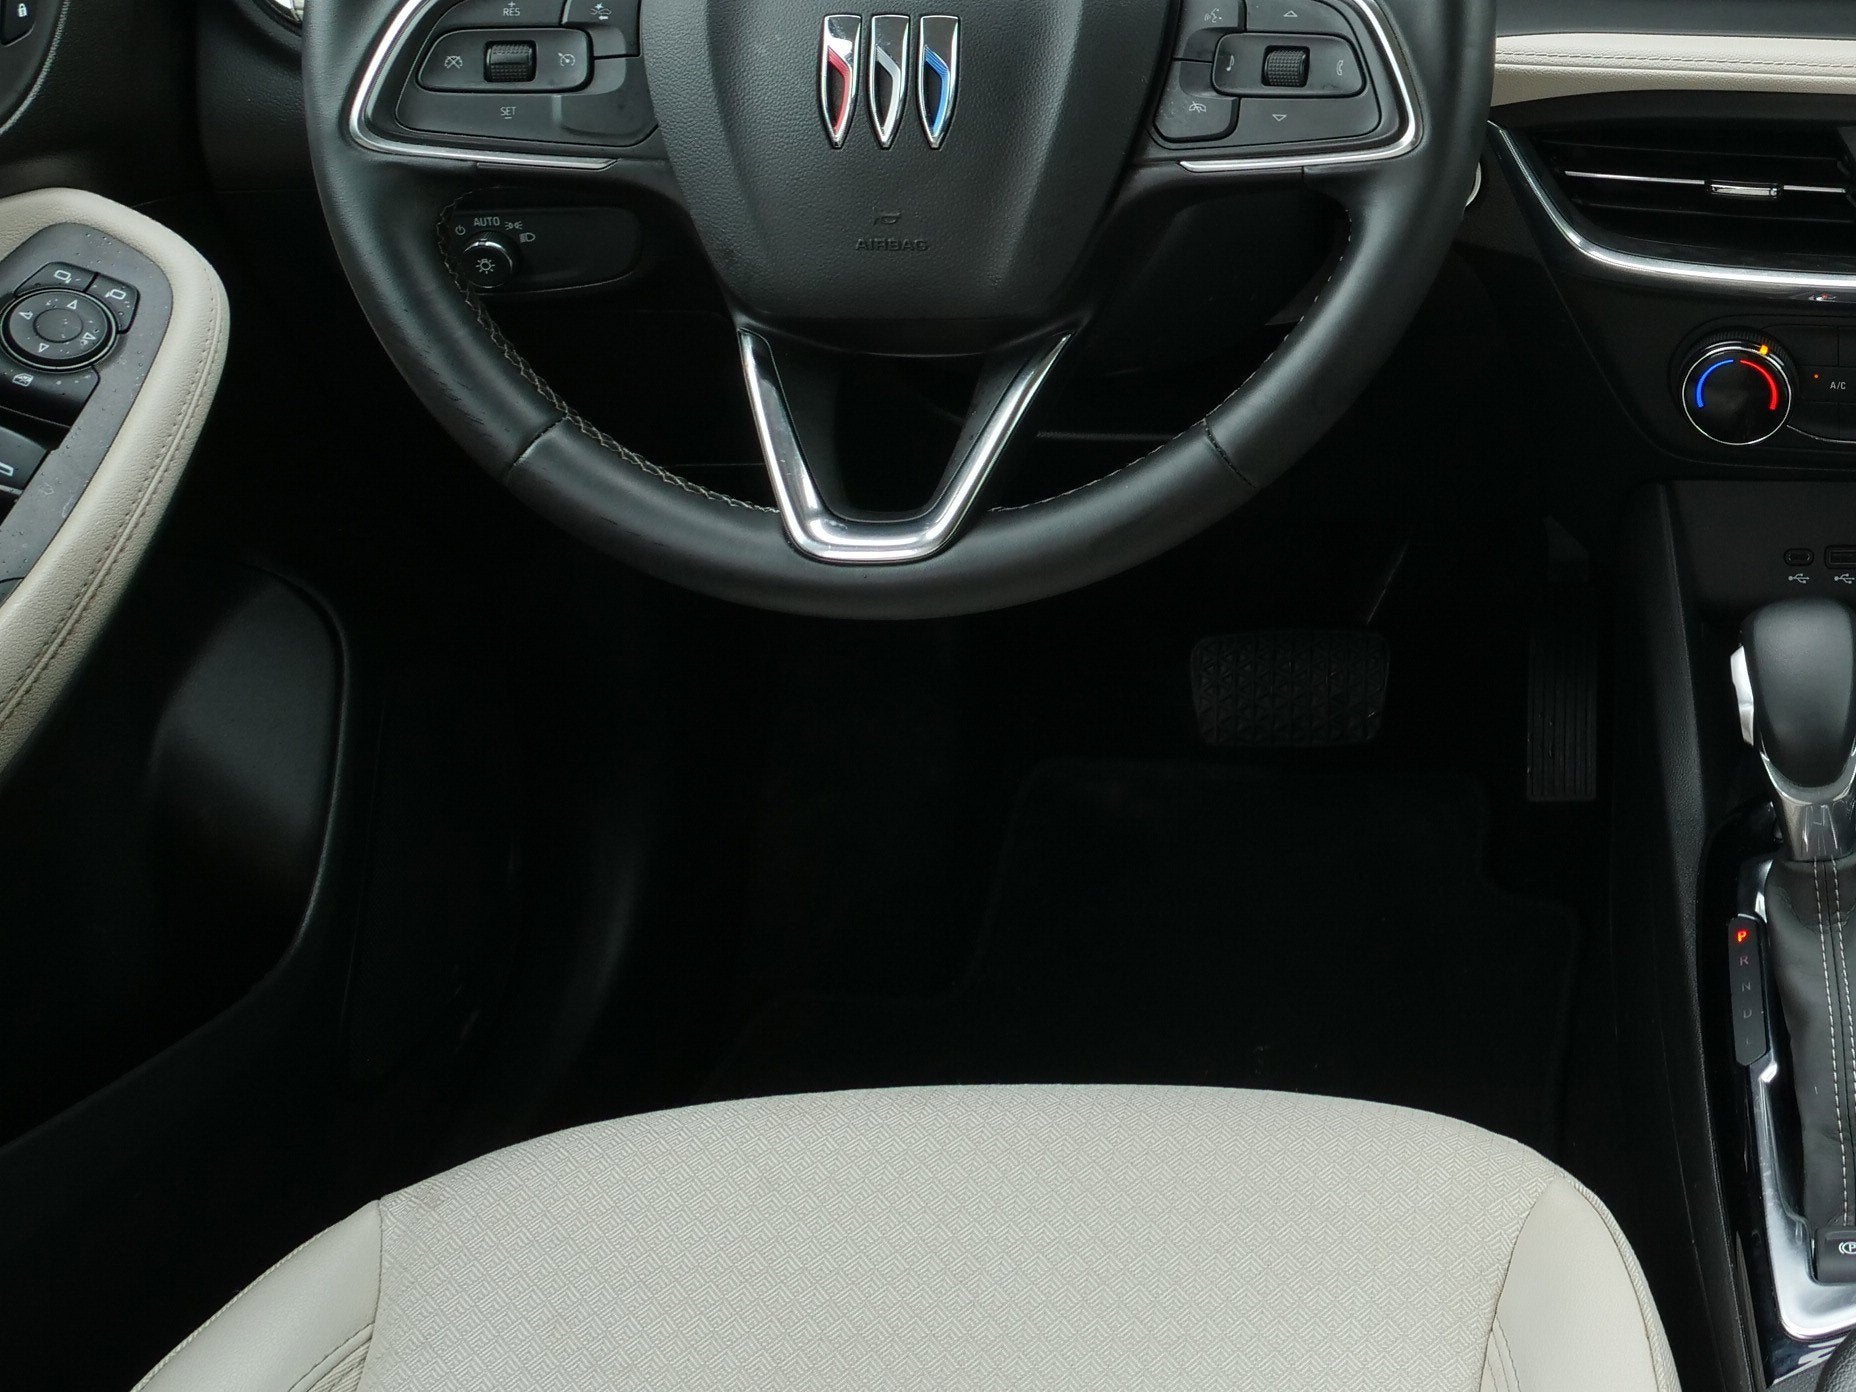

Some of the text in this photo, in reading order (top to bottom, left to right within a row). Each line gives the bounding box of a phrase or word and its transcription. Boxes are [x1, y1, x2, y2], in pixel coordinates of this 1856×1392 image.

[503, 8, 521, 17] RES
[500, 106, 517, 116] SET
[474, 217, 501, 227] AUTO
[855, 238, 929, 251] AIRBAG
[1830, 381, 1846, 390] A/C
[1737, 931, 1748, 942] P
[1740, 955, 1749, 966] R
[1742, 982, 1751, 992] N
[1743, 1009, 1752, 1019] D
